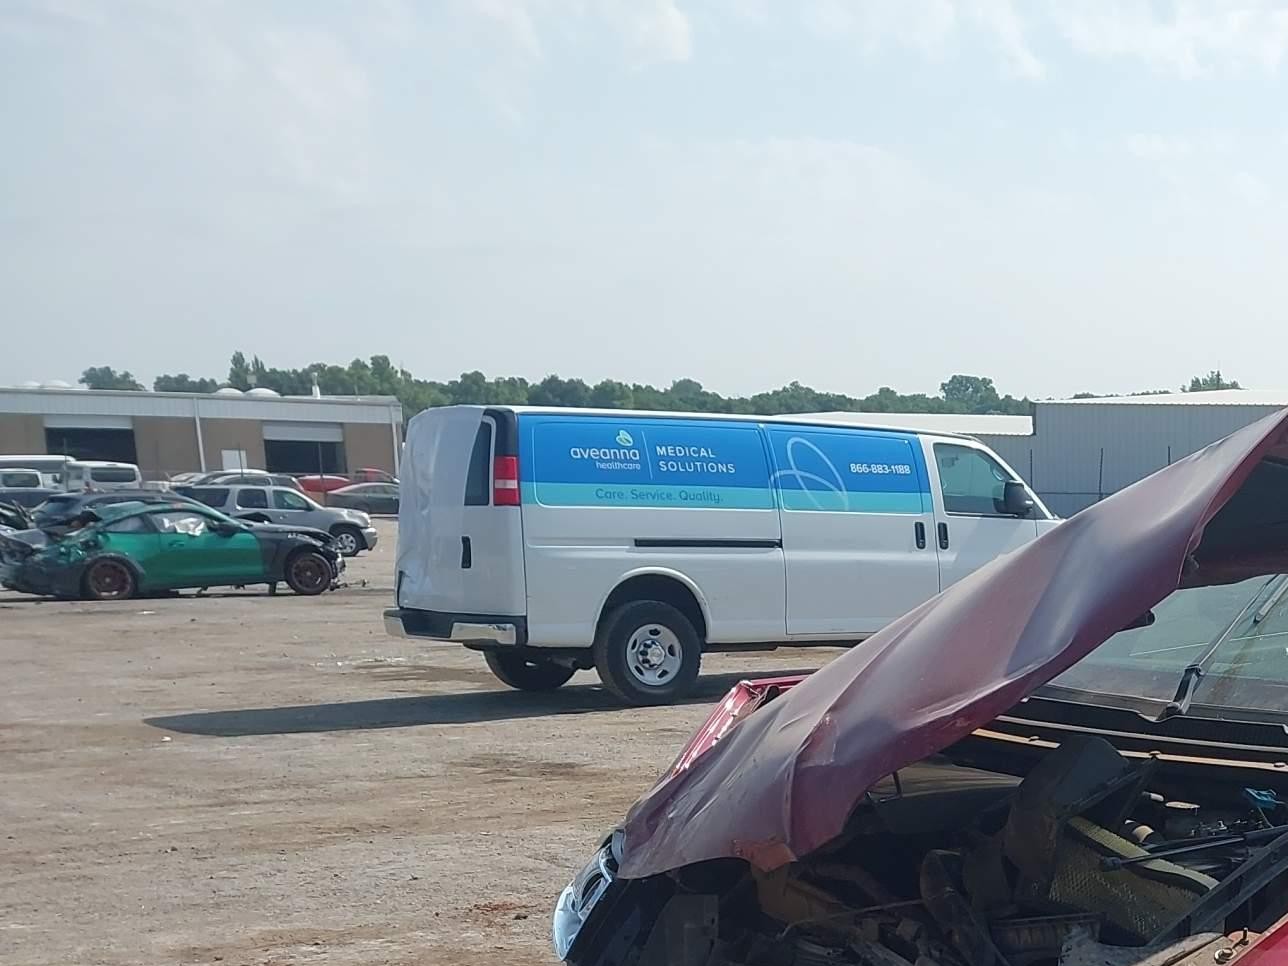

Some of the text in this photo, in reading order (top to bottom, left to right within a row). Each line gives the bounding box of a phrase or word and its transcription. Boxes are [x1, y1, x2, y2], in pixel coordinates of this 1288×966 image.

[570, 447, 640, 460] aveanna
[656, 445, 717, 458] MEDICAL
[595, 460, 641, 470] healthcare
[658, 460, 736, 474] SOLUTIONS
[849, 463, 911, 475] 866-883-1188
[679, 489, 724, 504] Quality.
